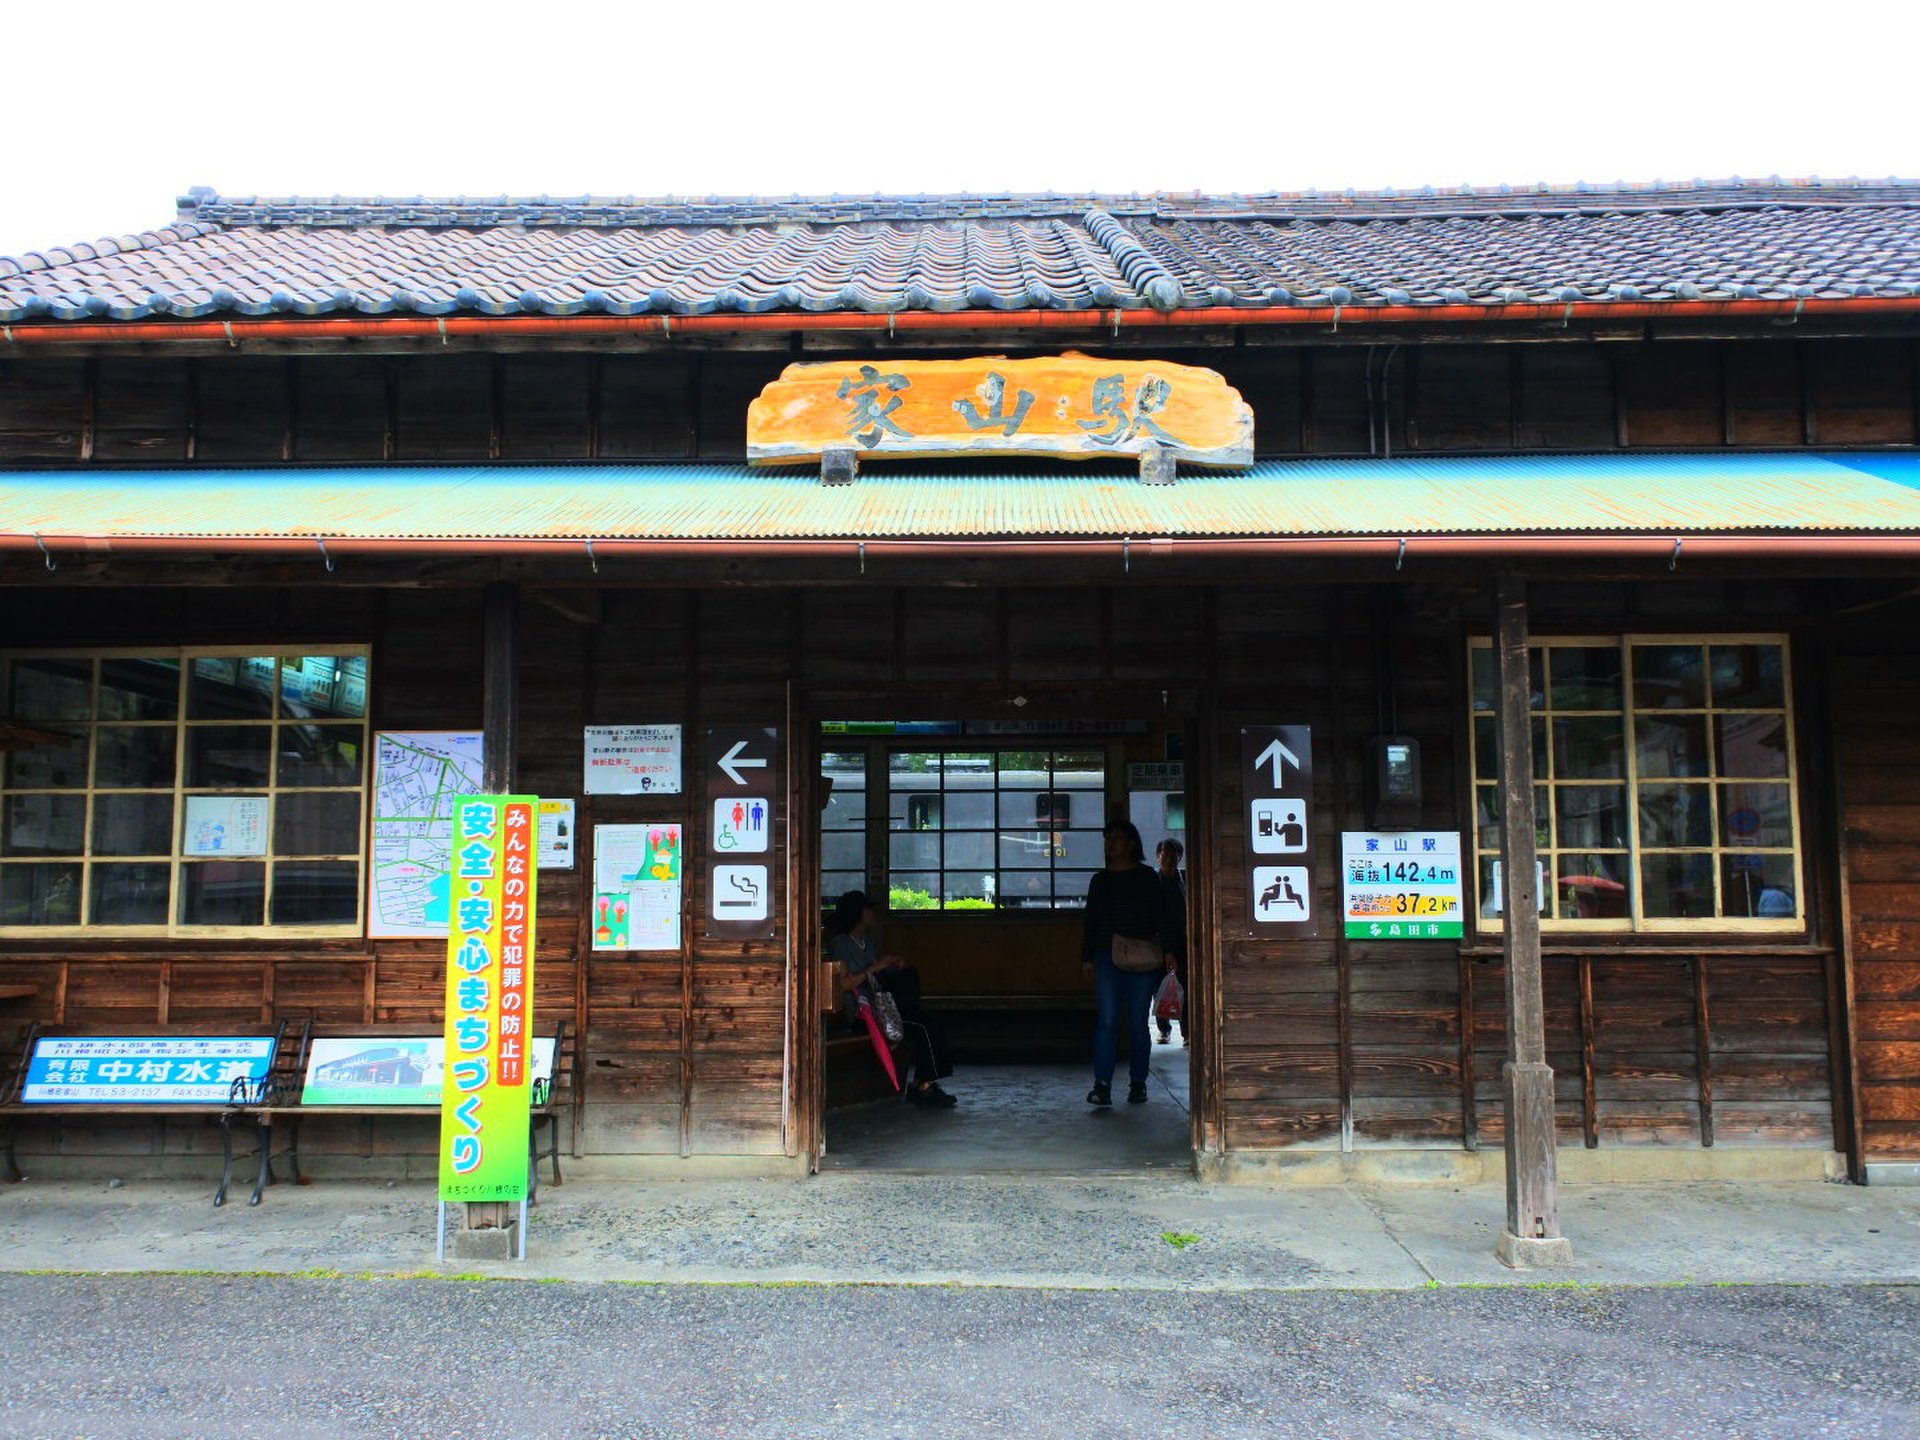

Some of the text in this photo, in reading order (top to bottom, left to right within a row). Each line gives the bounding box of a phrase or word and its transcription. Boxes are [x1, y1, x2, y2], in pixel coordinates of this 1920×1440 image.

[1365, 838, 1437, 851] 家山駅
[1348, 859, 1373, 869] ここは
[1351, 870, 1380, 882] 海抜
[1389, 923, 1439, 936] 島田市
[451, 803, 496, 1174] 安全・安心まちづくり
[47, 1059, 91, 1071] 有限
[97, 1059, 254, 1083] 中村水道
[44, 1071, 88, 1083] 会社
